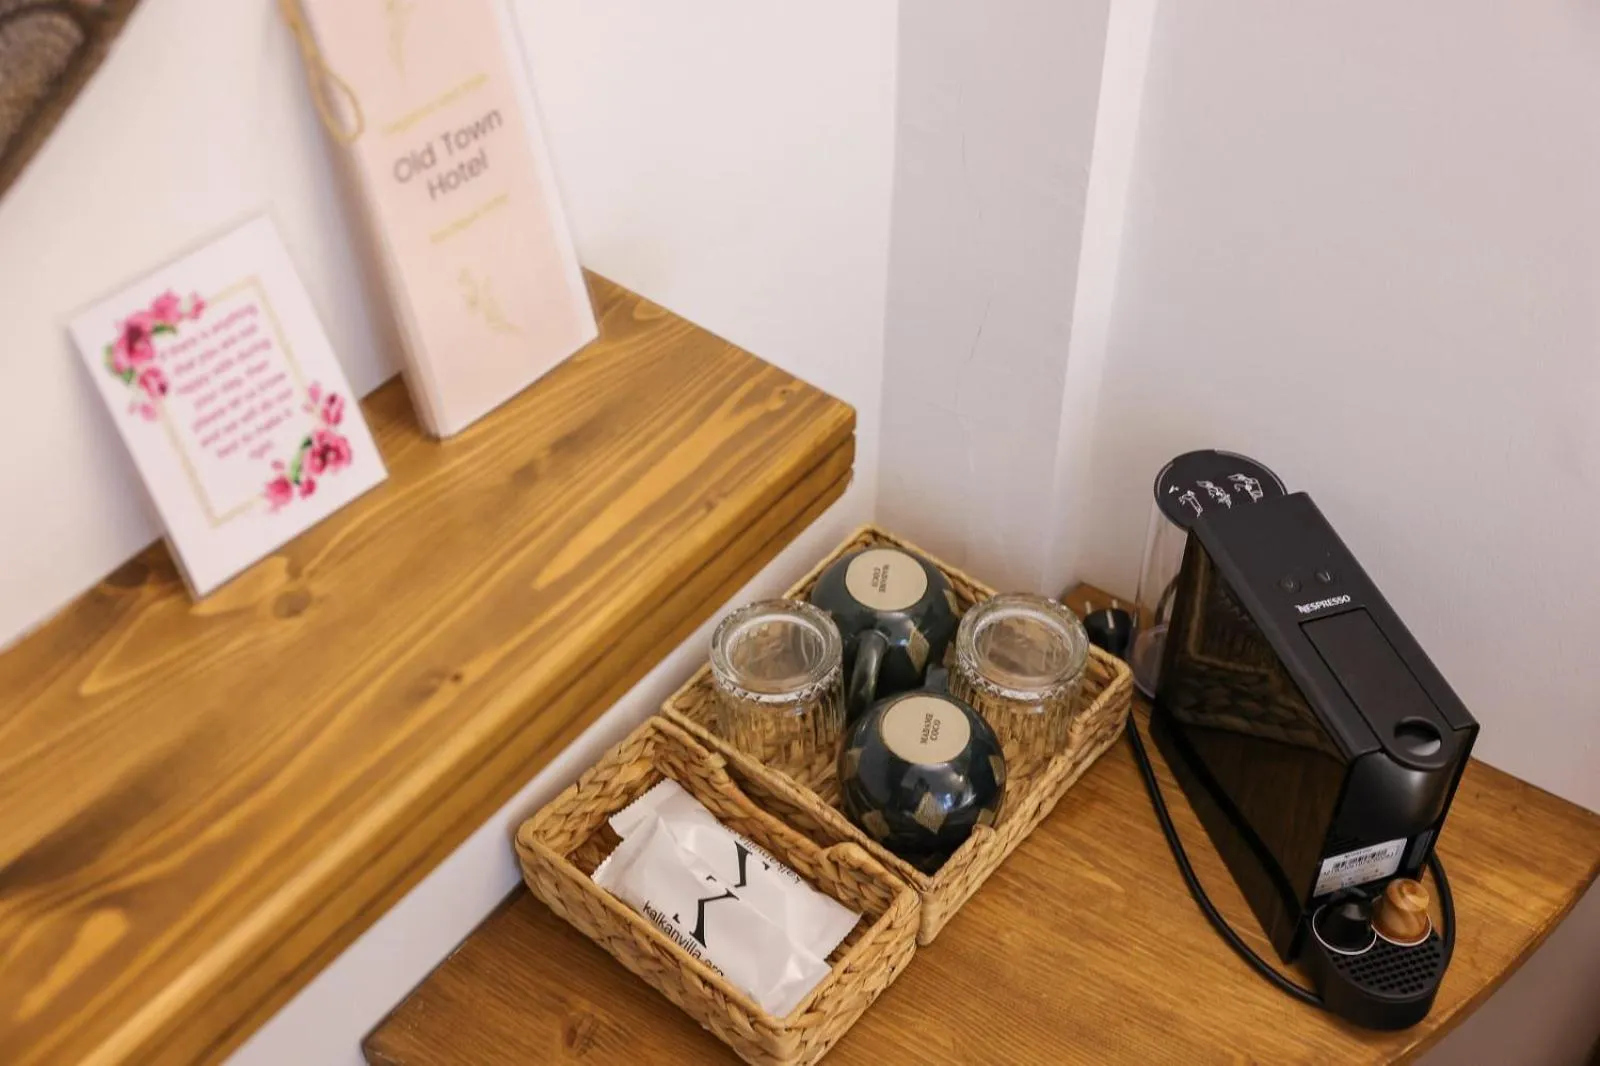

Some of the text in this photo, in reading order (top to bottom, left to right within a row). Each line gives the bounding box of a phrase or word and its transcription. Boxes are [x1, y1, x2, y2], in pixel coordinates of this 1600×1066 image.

[393, 109, 503, 184] Old Town
[427, 146, 488, 201] Hotel
[1295, 594, 1351, 613] NESPRESSO
[930, 719, 941, 741] COCO
